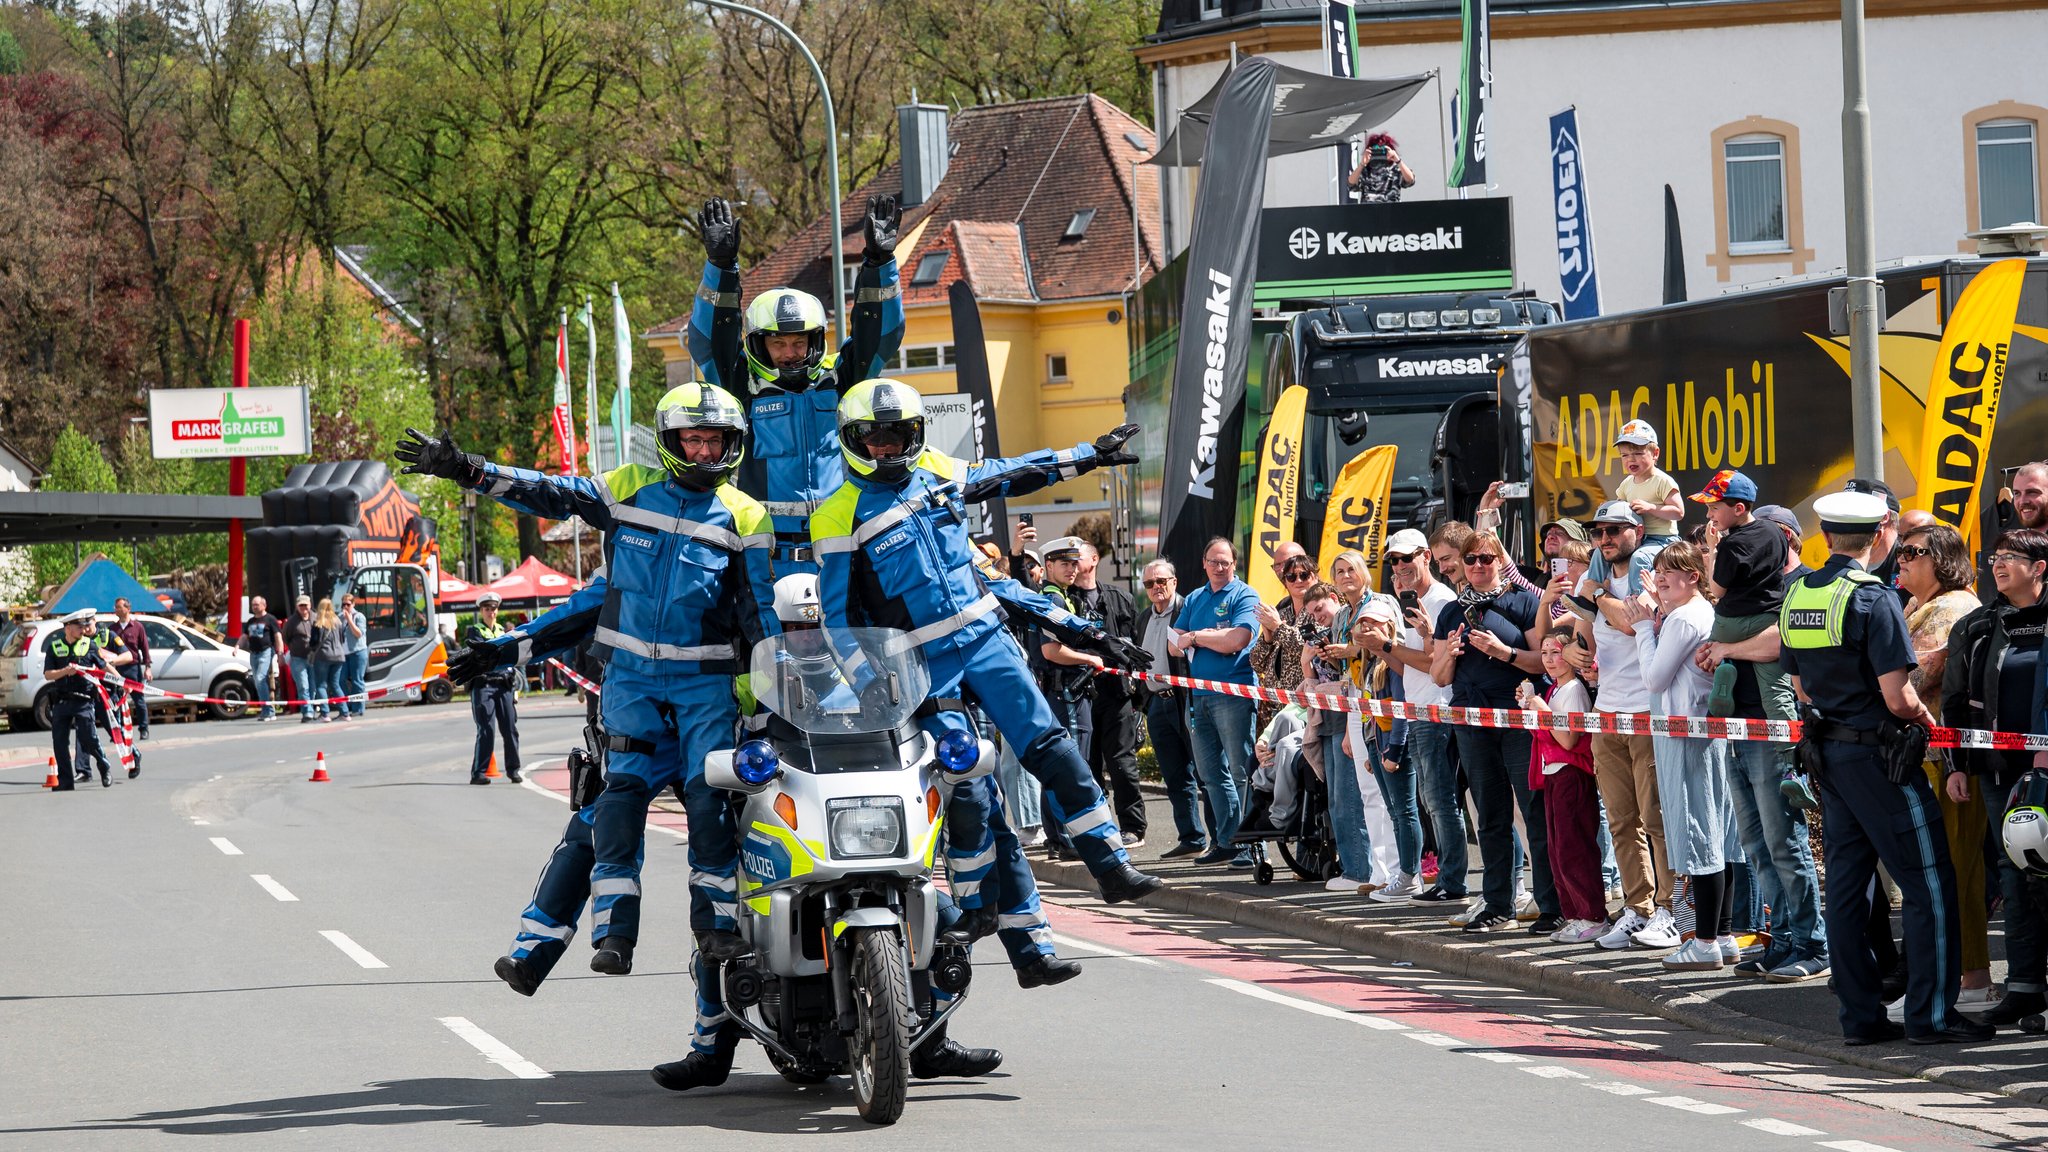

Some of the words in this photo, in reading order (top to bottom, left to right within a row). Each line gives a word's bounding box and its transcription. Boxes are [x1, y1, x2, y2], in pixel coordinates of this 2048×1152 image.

[1327, 226, 1462, 255] Kawasaki
[1378, 353, 1505, 378] Kawasak
[1188, 268, 1232, 499] Kawasaki
[924, 402, 966, 415] SWÄRTS
[1665, 360, 1776, 472] Mobil
[178, 421, 278, 437] MARKGRAFEN
[1932, 341, 1991, 529] ADAC
[1260, 433, 1290, 562] ADAC
[1338, 497, 1374, 552] AC
[621, 534, 652, 548] POLIZEI
[874, 531, 907, 554] POLIZEI
[1789, 612, 1825, 626] POLIZEI
[409, 687, 417, 696] 16
[742, 849, 777, 880] POLIZEI
